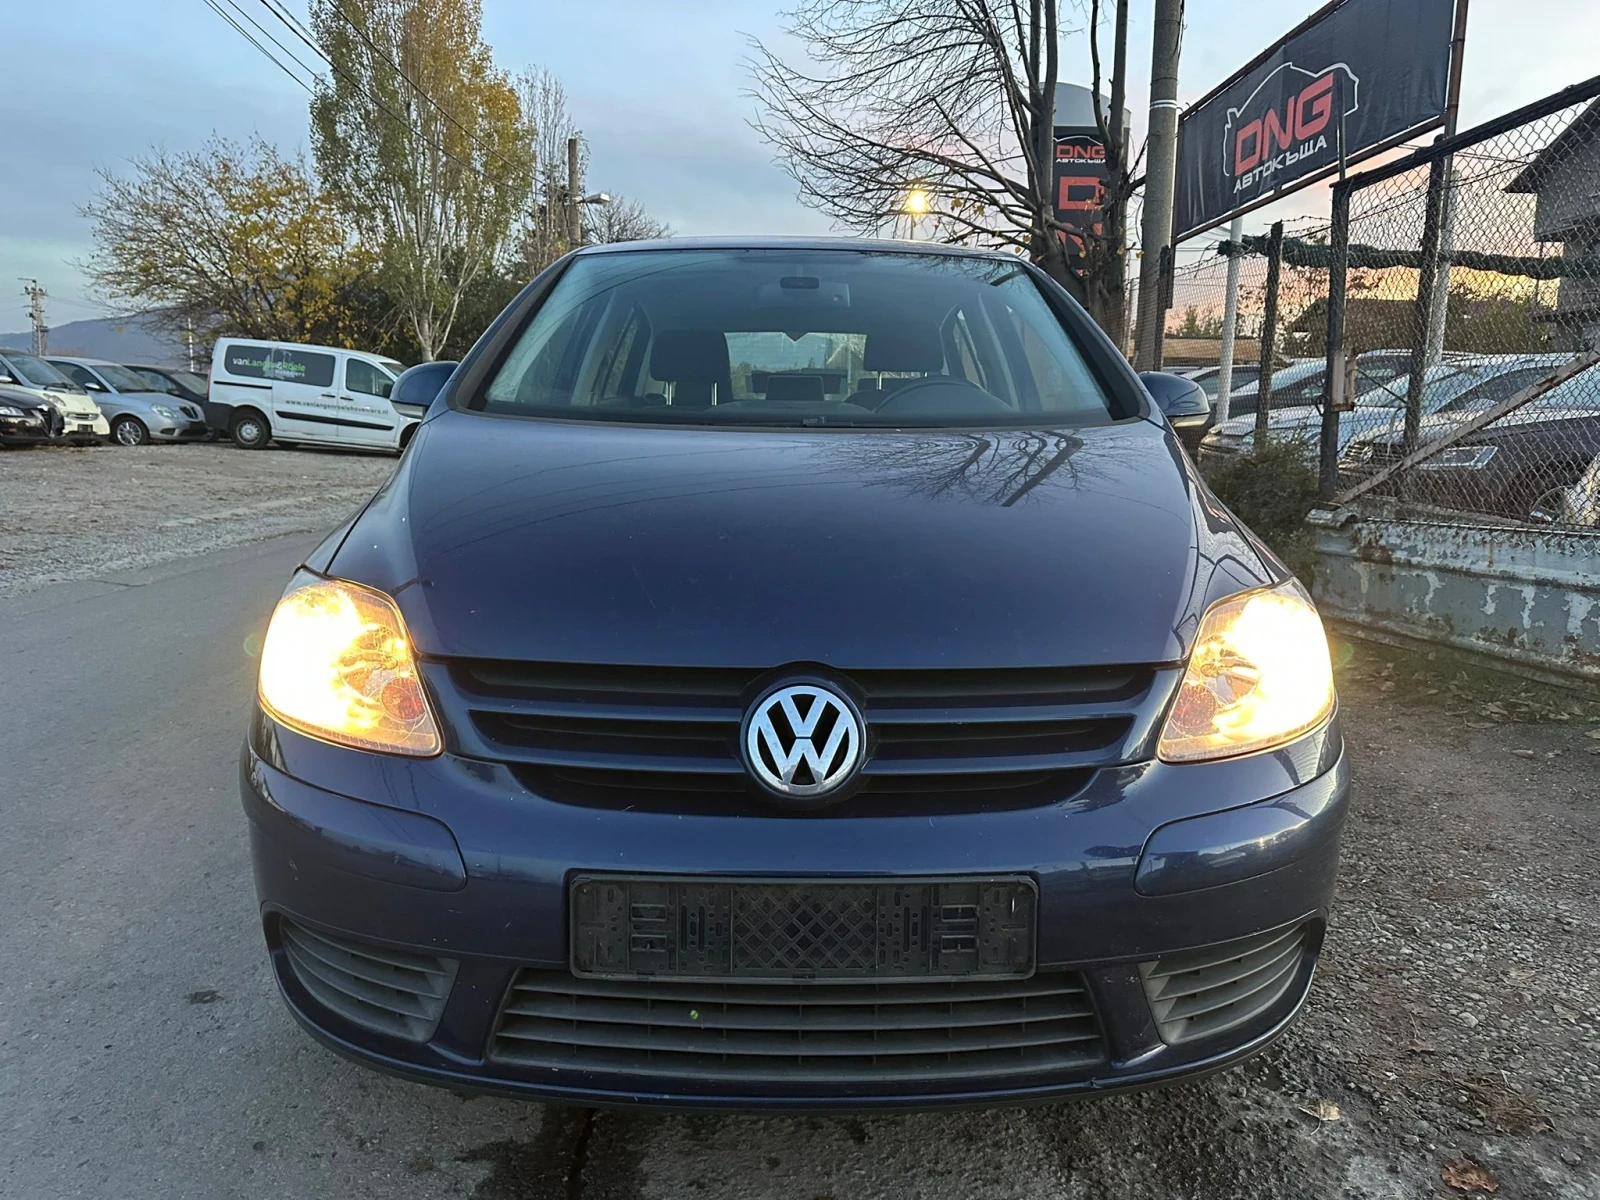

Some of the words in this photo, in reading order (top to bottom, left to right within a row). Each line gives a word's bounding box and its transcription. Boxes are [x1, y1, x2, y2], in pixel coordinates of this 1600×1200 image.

[1056, 144, 1106, 159] DNG
[1233, 134, 1328, 194] АВТОКЪША
[1234, 72, 1334, 177] DNG
[748, 686, 859, 795] VW
